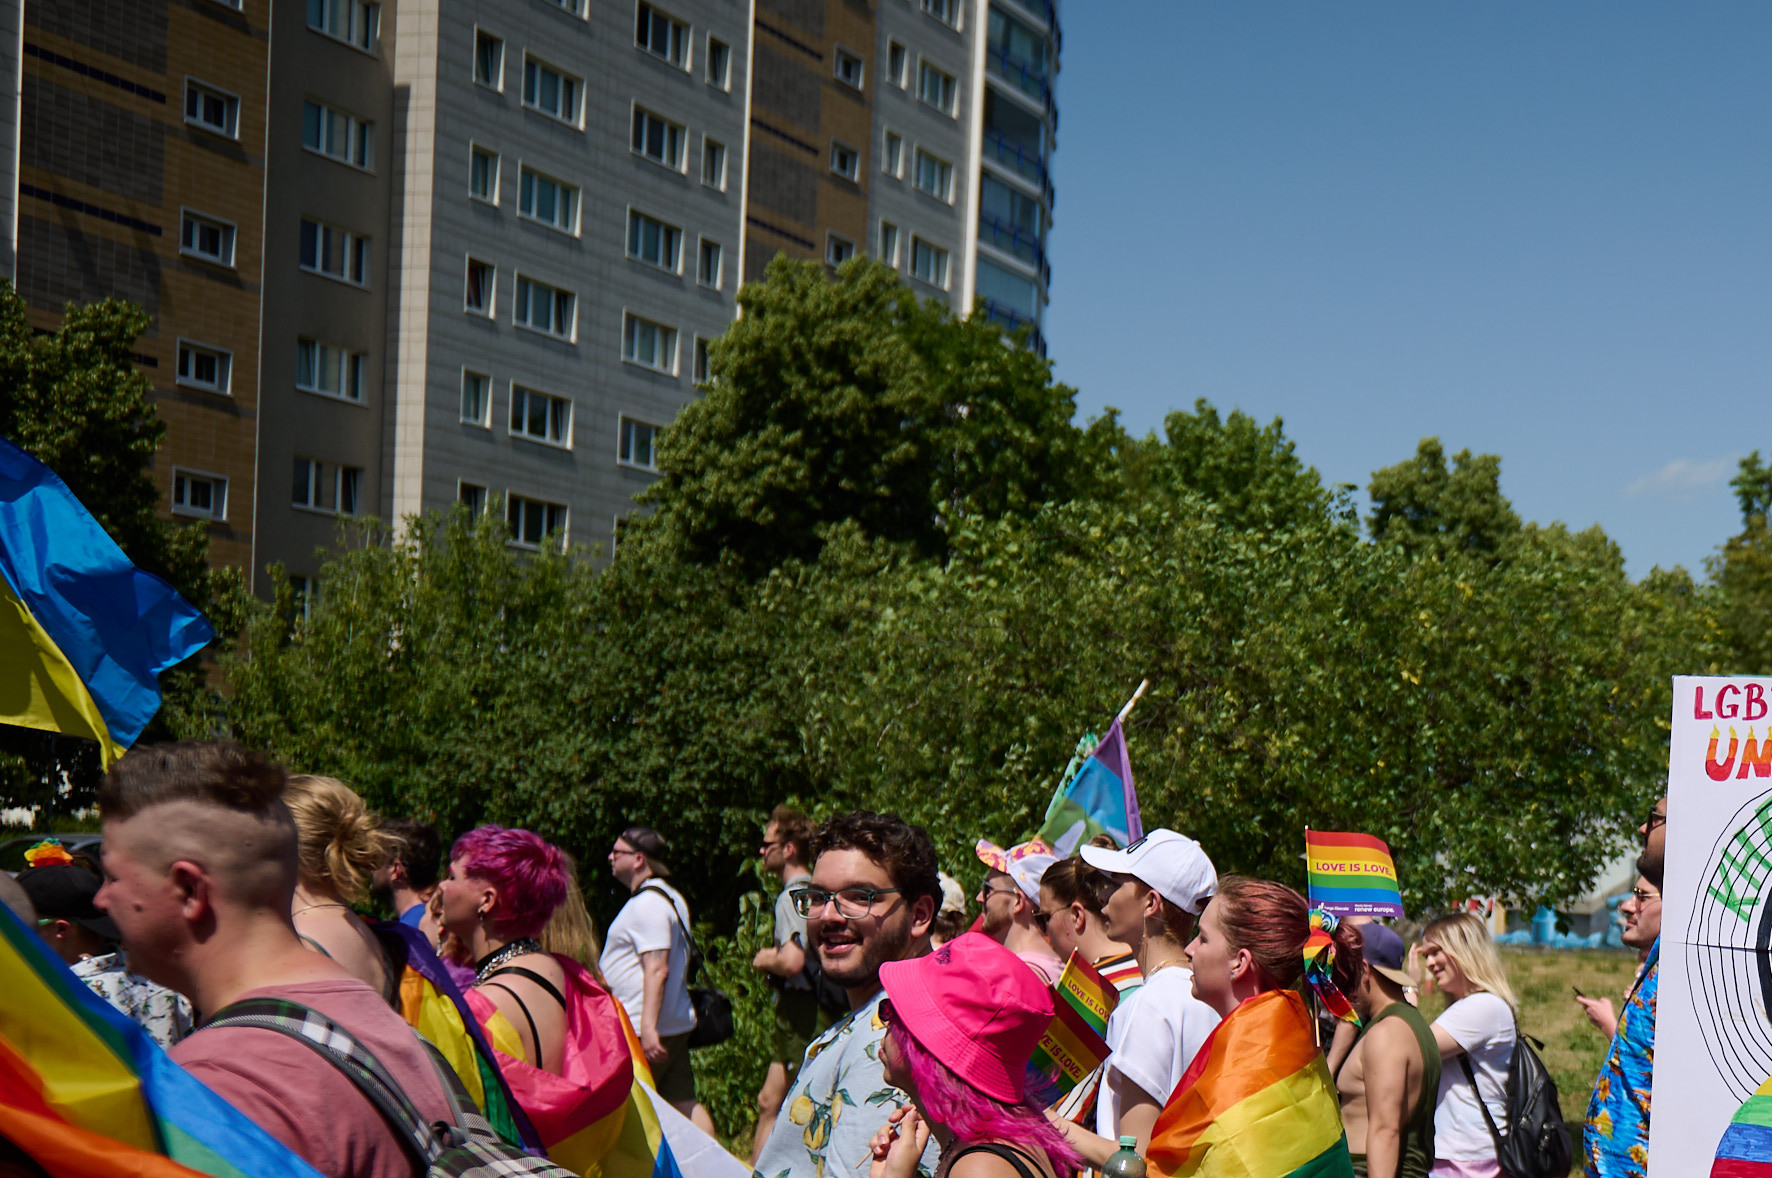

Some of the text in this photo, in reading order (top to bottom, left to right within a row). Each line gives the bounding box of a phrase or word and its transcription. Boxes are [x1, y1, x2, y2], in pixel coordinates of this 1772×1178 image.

[1316, 862, 1345, 871] LOVE
[1349, 863, 1361, 872] IS
[1068, 980, 1110, 1021] LOVE IS LOV
[1050, 1044, 1062, 1056] IS
